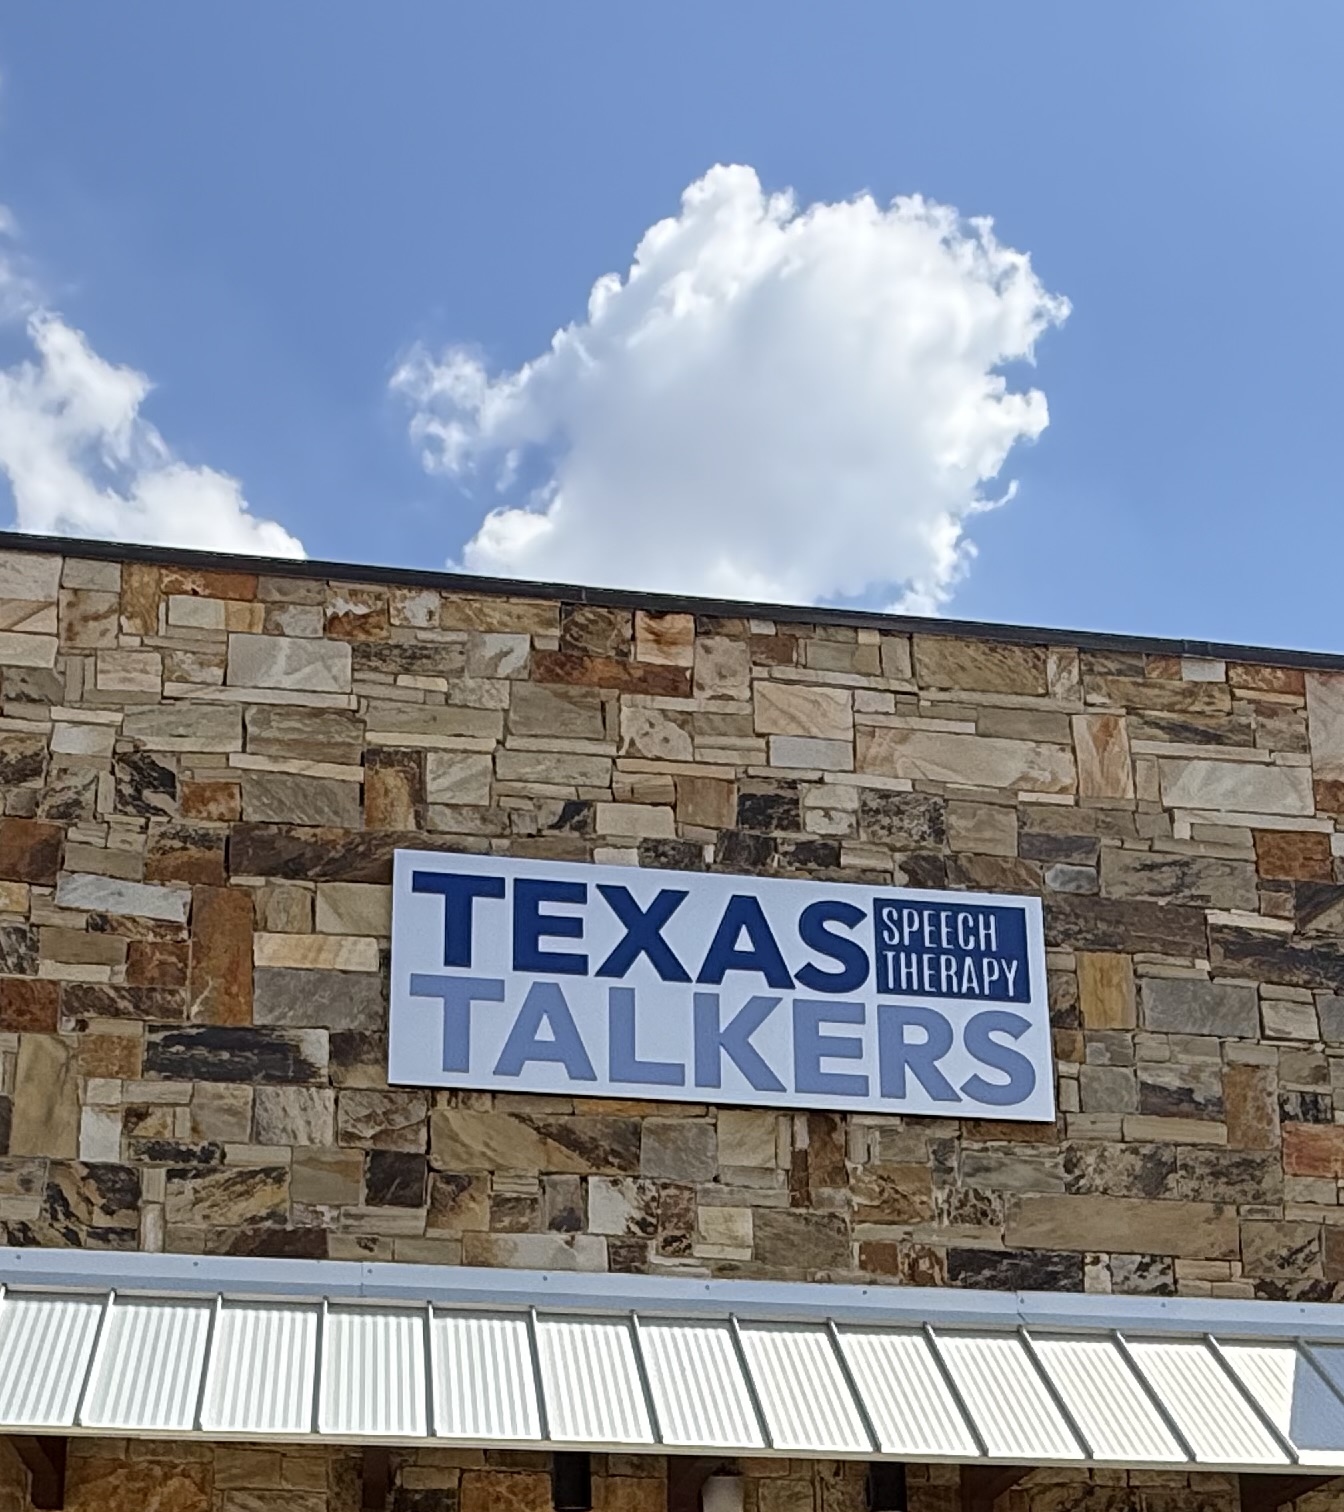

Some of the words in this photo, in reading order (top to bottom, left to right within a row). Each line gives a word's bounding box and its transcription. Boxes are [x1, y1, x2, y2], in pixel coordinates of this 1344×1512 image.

[411, 870, 871, 994] TEXAS
[881, 906, 998, 952] SPEECH
[882, 951, 1018, 997] THERAPY
[408, 972, 1037, 1106] TALKERS
